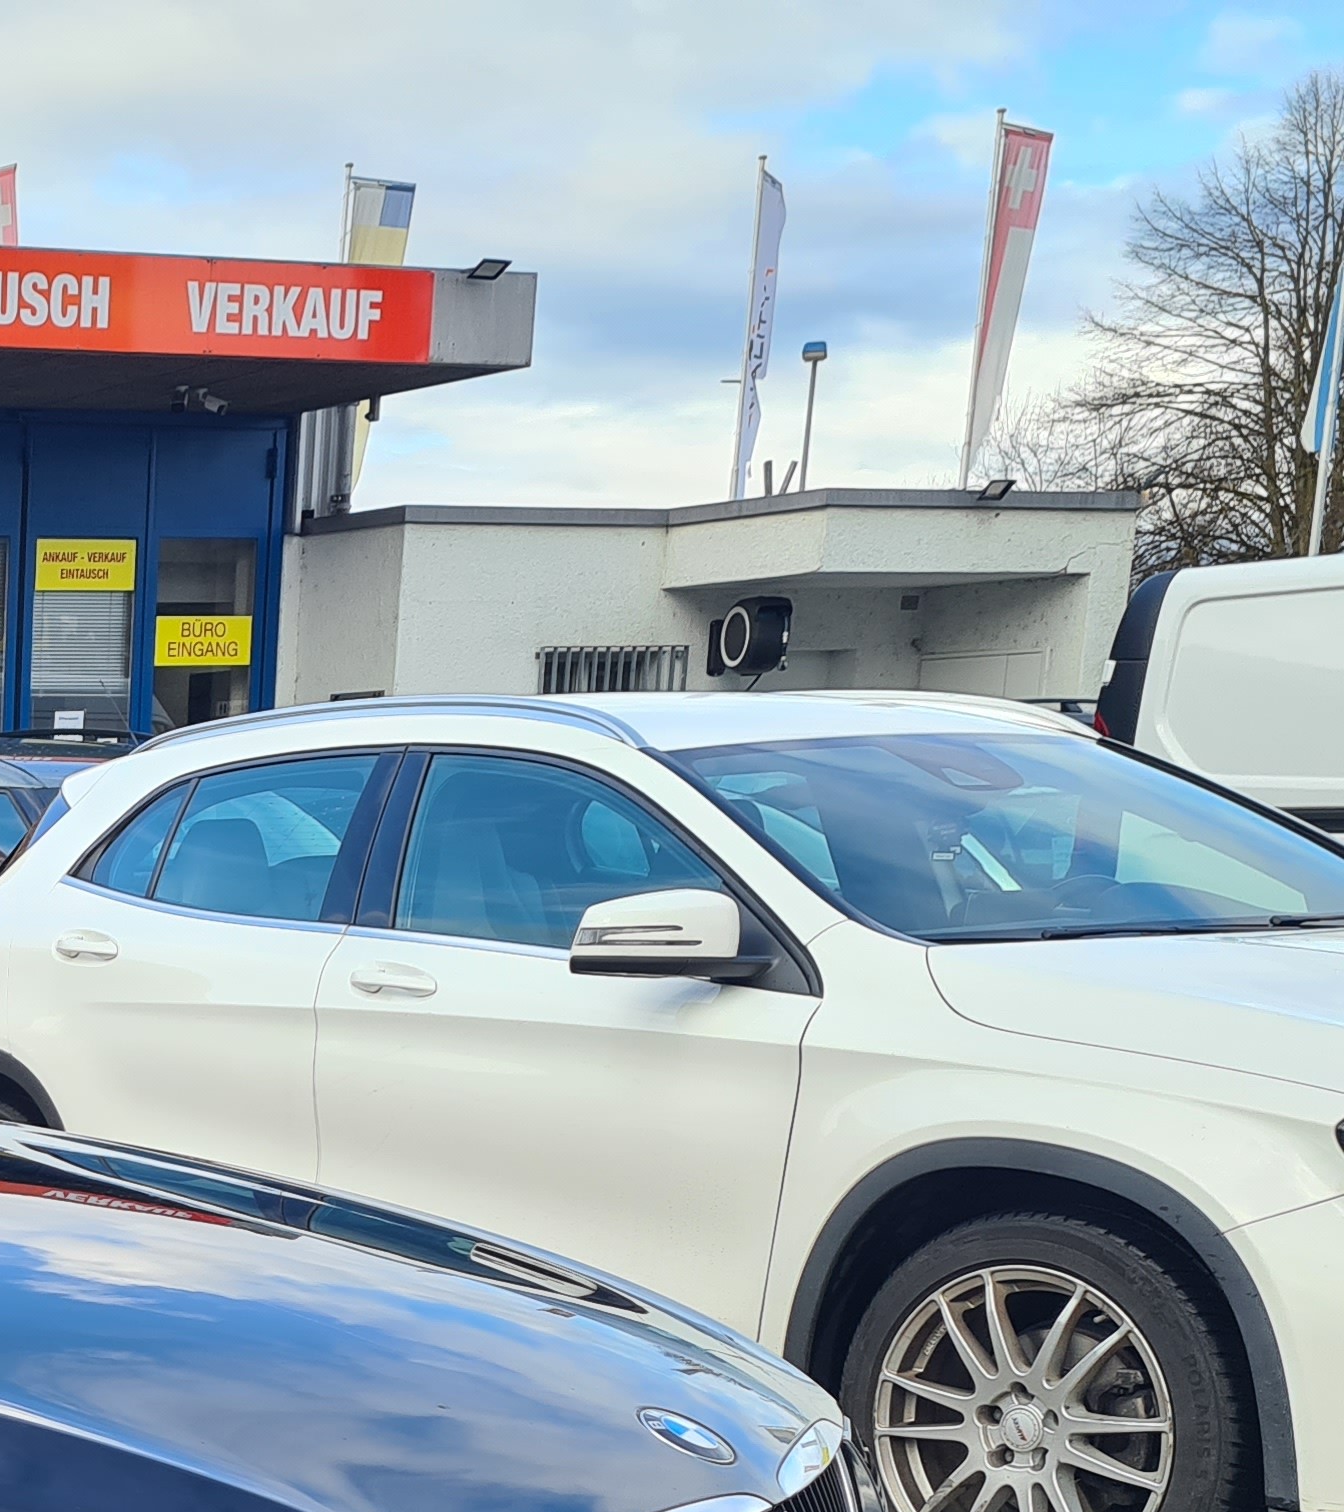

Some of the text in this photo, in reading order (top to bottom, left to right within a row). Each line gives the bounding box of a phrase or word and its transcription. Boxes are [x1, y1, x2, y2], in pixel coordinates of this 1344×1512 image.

[187, 279, 383, 342] VERKAUF
[41, 550, 79, 564] ANKAUF
[87, 550, 128, 565] VERKAUF
[59, 567, 110, 581] EINTAUSCH
[180, 619, 226, 638] BÜRO
[166, 640, 239, 659] EINGANG
